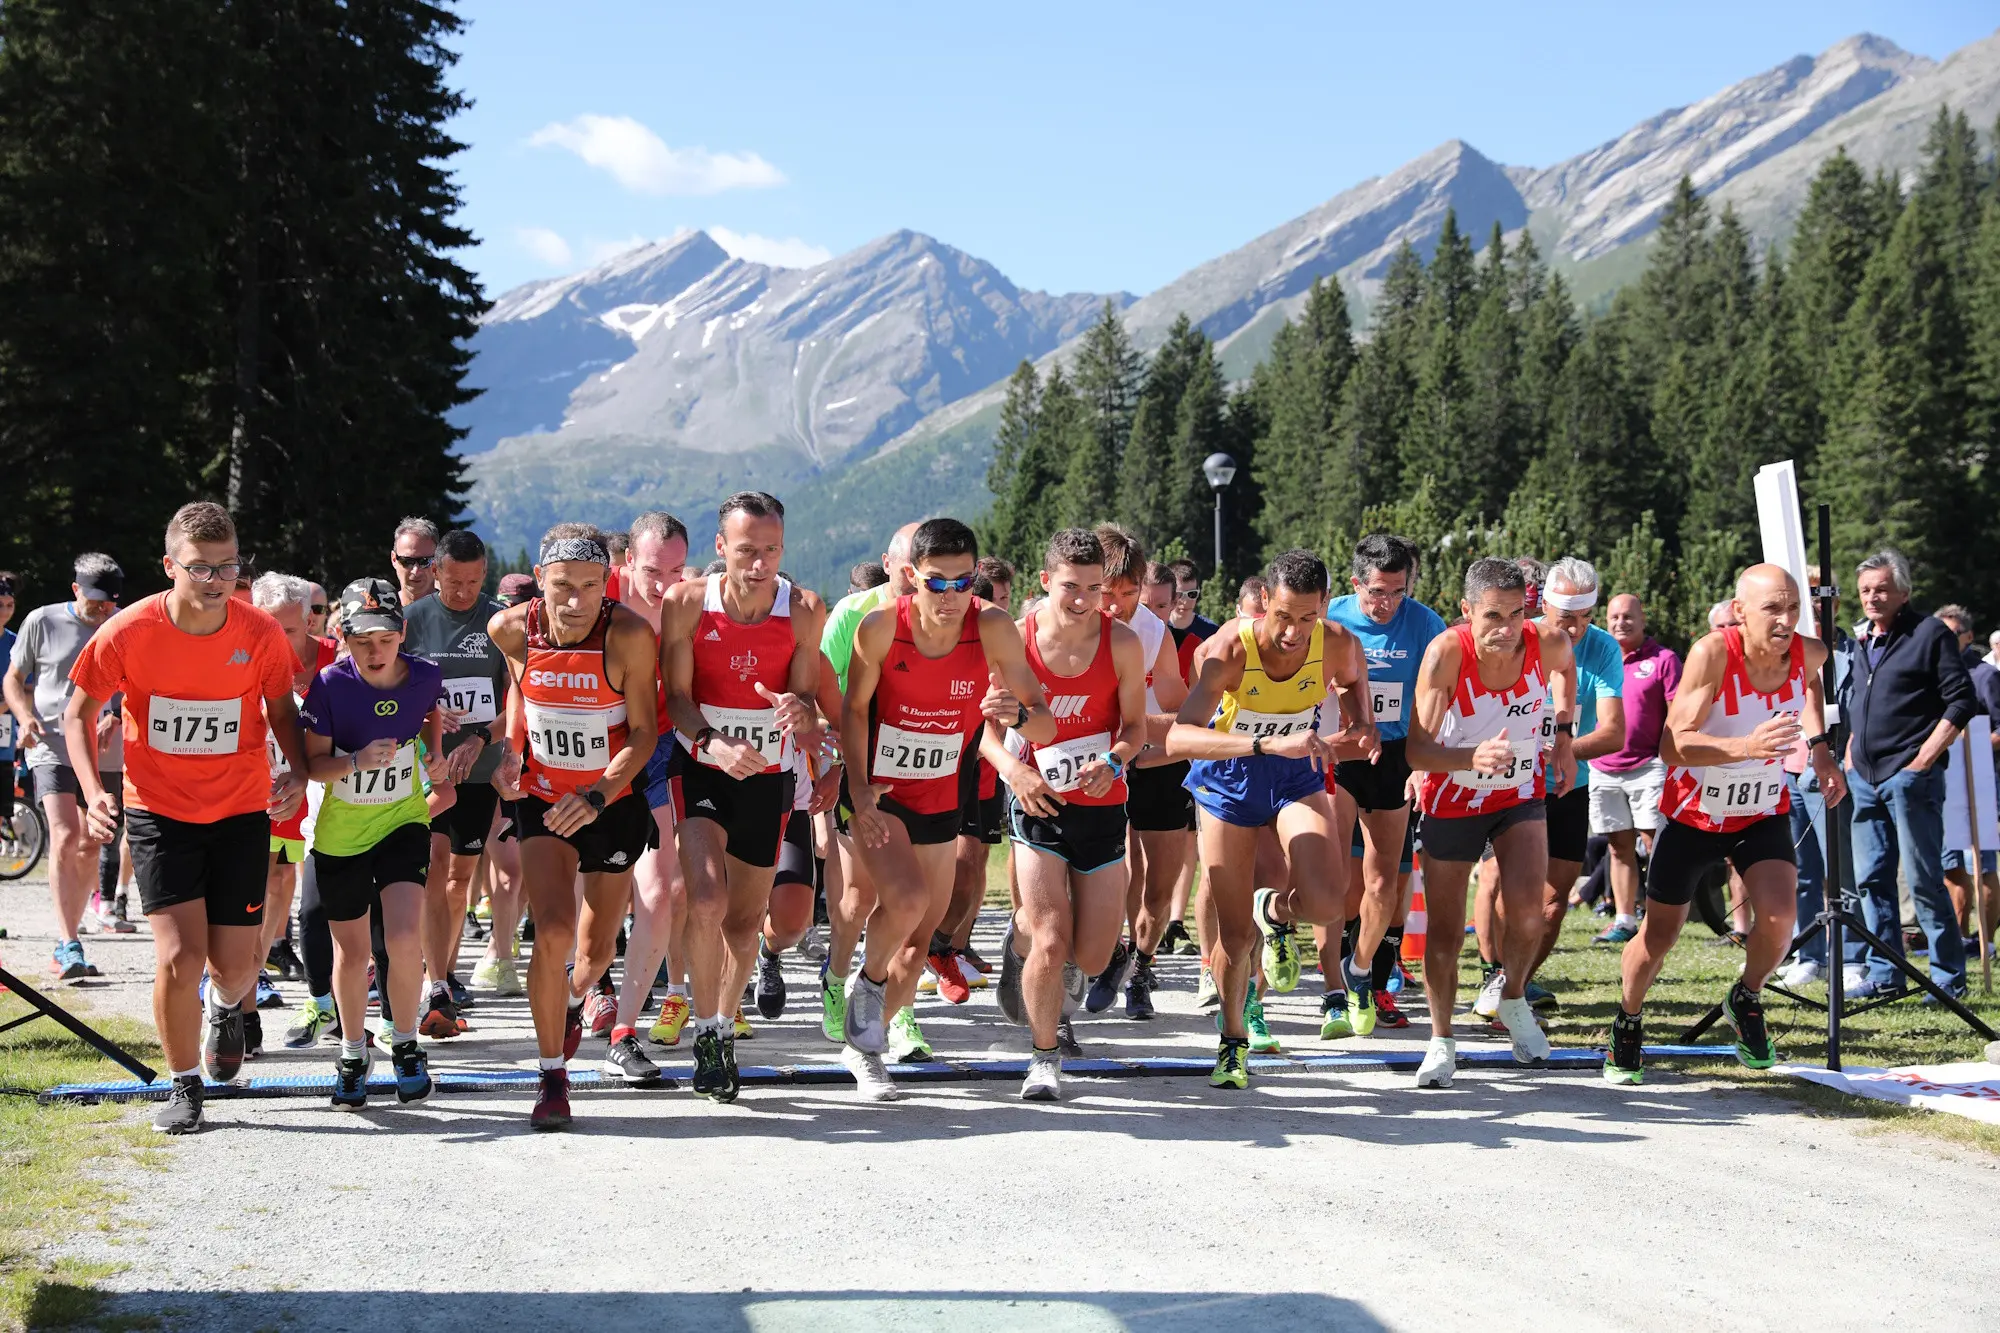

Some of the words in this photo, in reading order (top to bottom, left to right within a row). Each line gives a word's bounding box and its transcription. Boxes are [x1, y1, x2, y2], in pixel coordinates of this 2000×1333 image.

[1364, 648, 1407, 658] OOKS
[950, 680, 975, 696] USC
[910, 705, 960, 716] BancaStato
[1506, 698, 1541, 717] RCB
[173, 716, 219, 742] 175
[1254, 722, 1293, 736] 184
[544, 729, 586, 758] 196
[548, 760, 585, 769] RAIFFEISEN
[896, 746, 943, 768] 260
[353, 766, 396, 794] 176
[1727, 781, 1761, 806] 181
